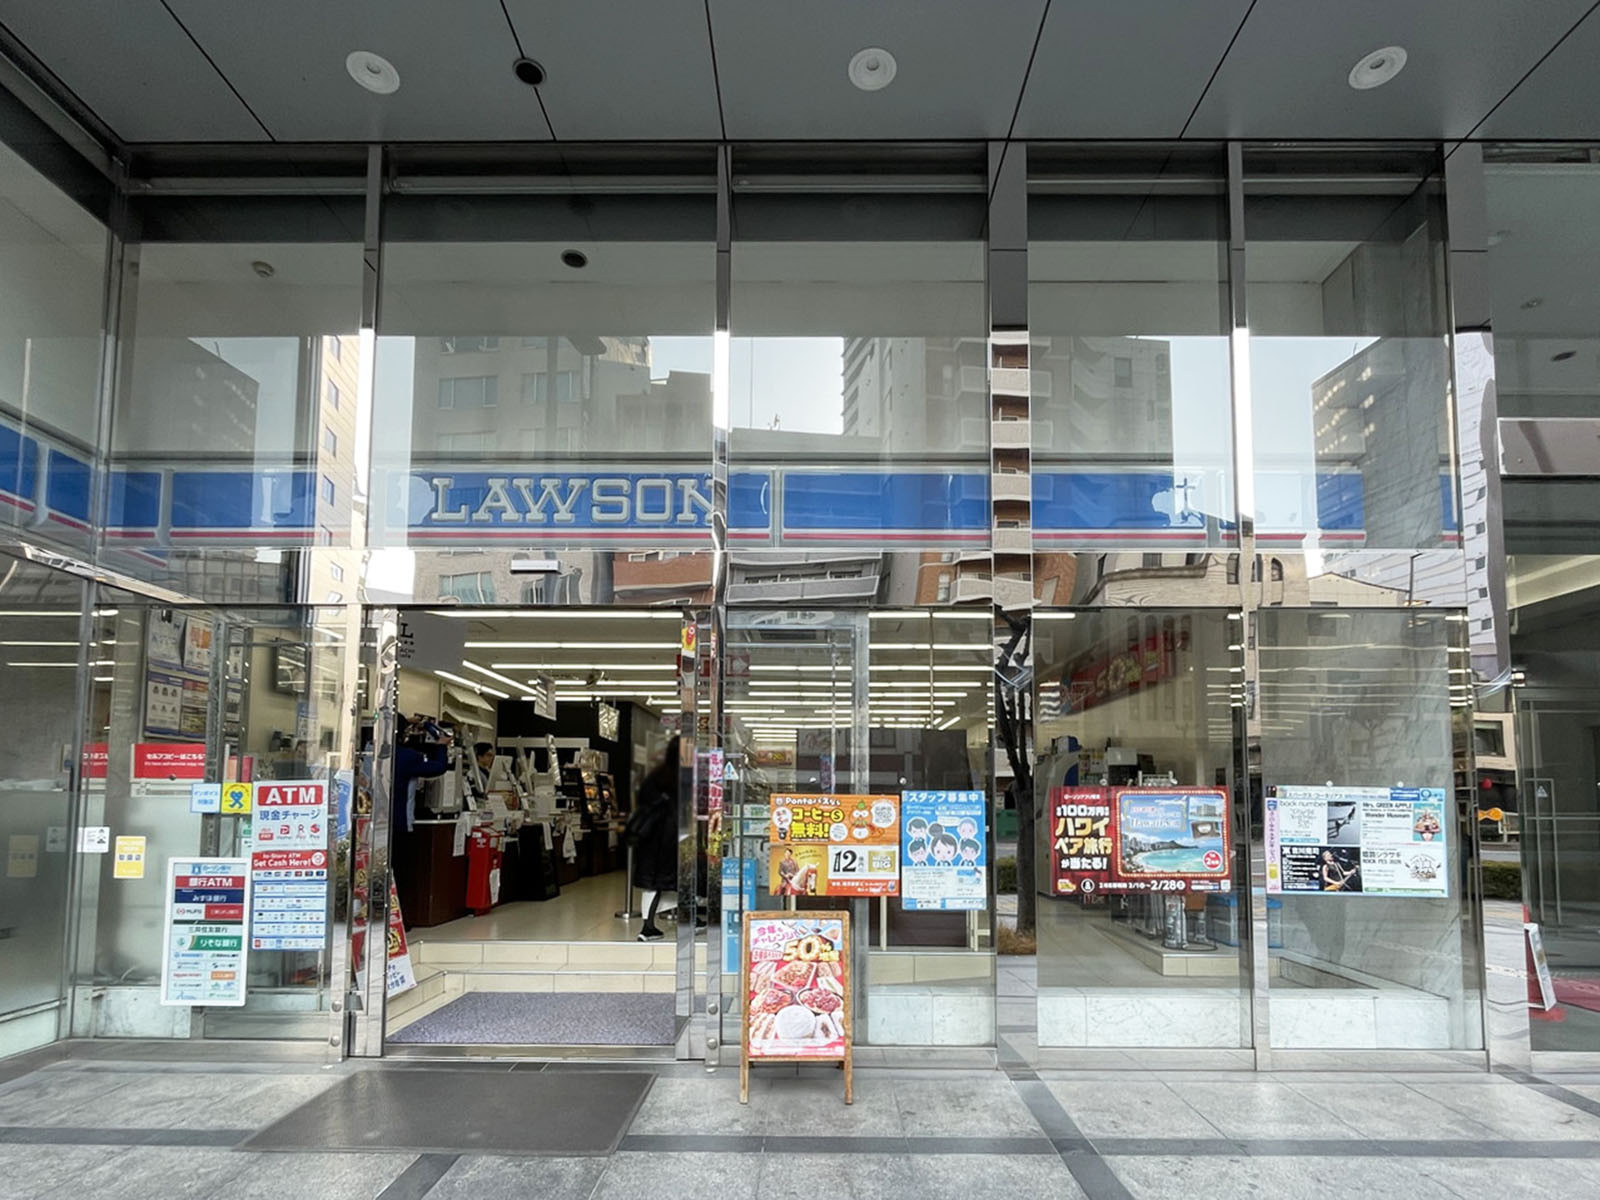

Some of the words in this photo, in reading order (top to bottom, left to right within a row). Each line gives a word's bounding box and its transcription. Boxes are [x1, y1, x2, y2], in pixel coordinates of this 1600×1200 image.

[431, 477, 714, 523] LAWSON
[265, 787, 315, 804] ATM
[909, 791, 979, 803] スタッフ募集中
[259, 809, 320, 821] 現金チャージ
[1055, 817, 1110, 837] ハワイ
[1054, 837, 1113, 855] ペア旅行
[253, 859, 267, 867] Get
[269, 859, 287, 867] Cash
[289, 858, 311, 867] Here!
[1060, 857, 1108, 870] が当たる!
[189, 877, 232, 887] 銀行ATM
[200, 938, 237, 948] りそな銀行
